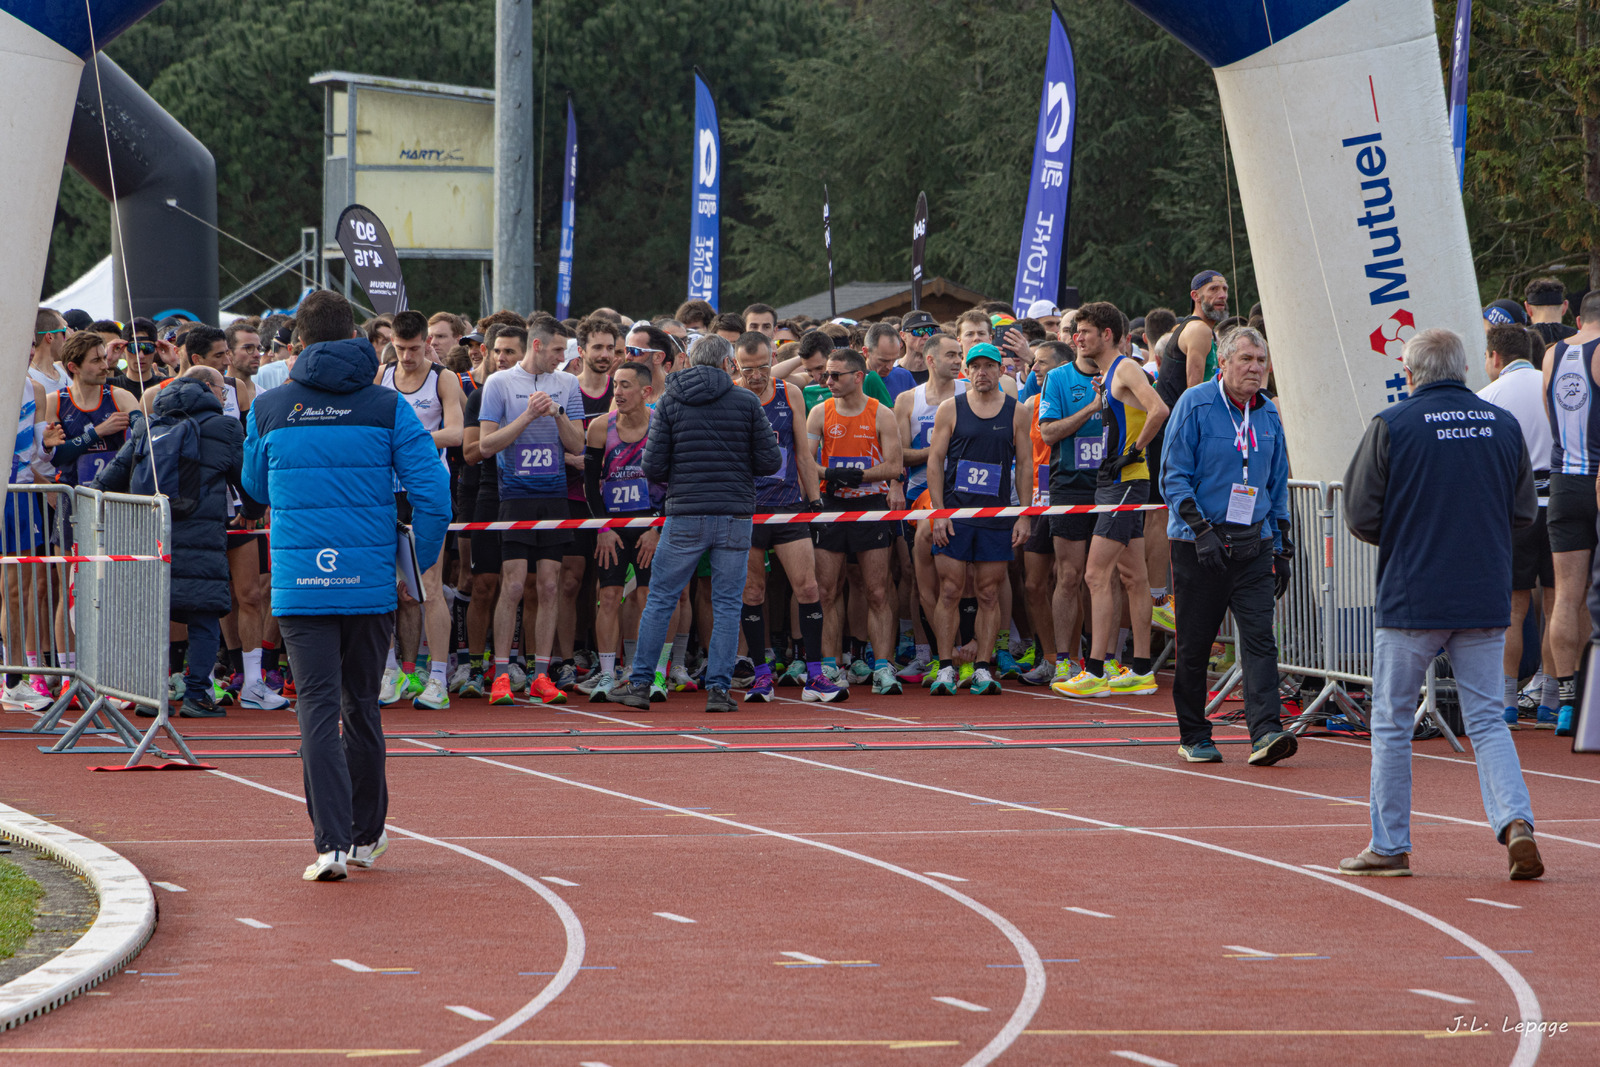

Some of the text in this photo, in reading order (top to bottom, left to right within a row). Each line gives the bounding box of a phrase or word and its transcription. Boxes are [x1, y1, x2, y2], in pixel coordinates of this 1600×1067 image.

[399, 149, 445, 160] MARTY
[1342, 132, 1410, 305] Mutuel
[301, 407, 324, 416] Alexis
[1423, 410, 1496, 423] PHOTO CLUB
[1436, 427, 1492, 440] DECLIC 49
[521, 448, 553, 467] 223
[1080, 442, 1103, 461] 39
[968, 467, 989, 486] 32
[612, 485, 641, 504] 274
